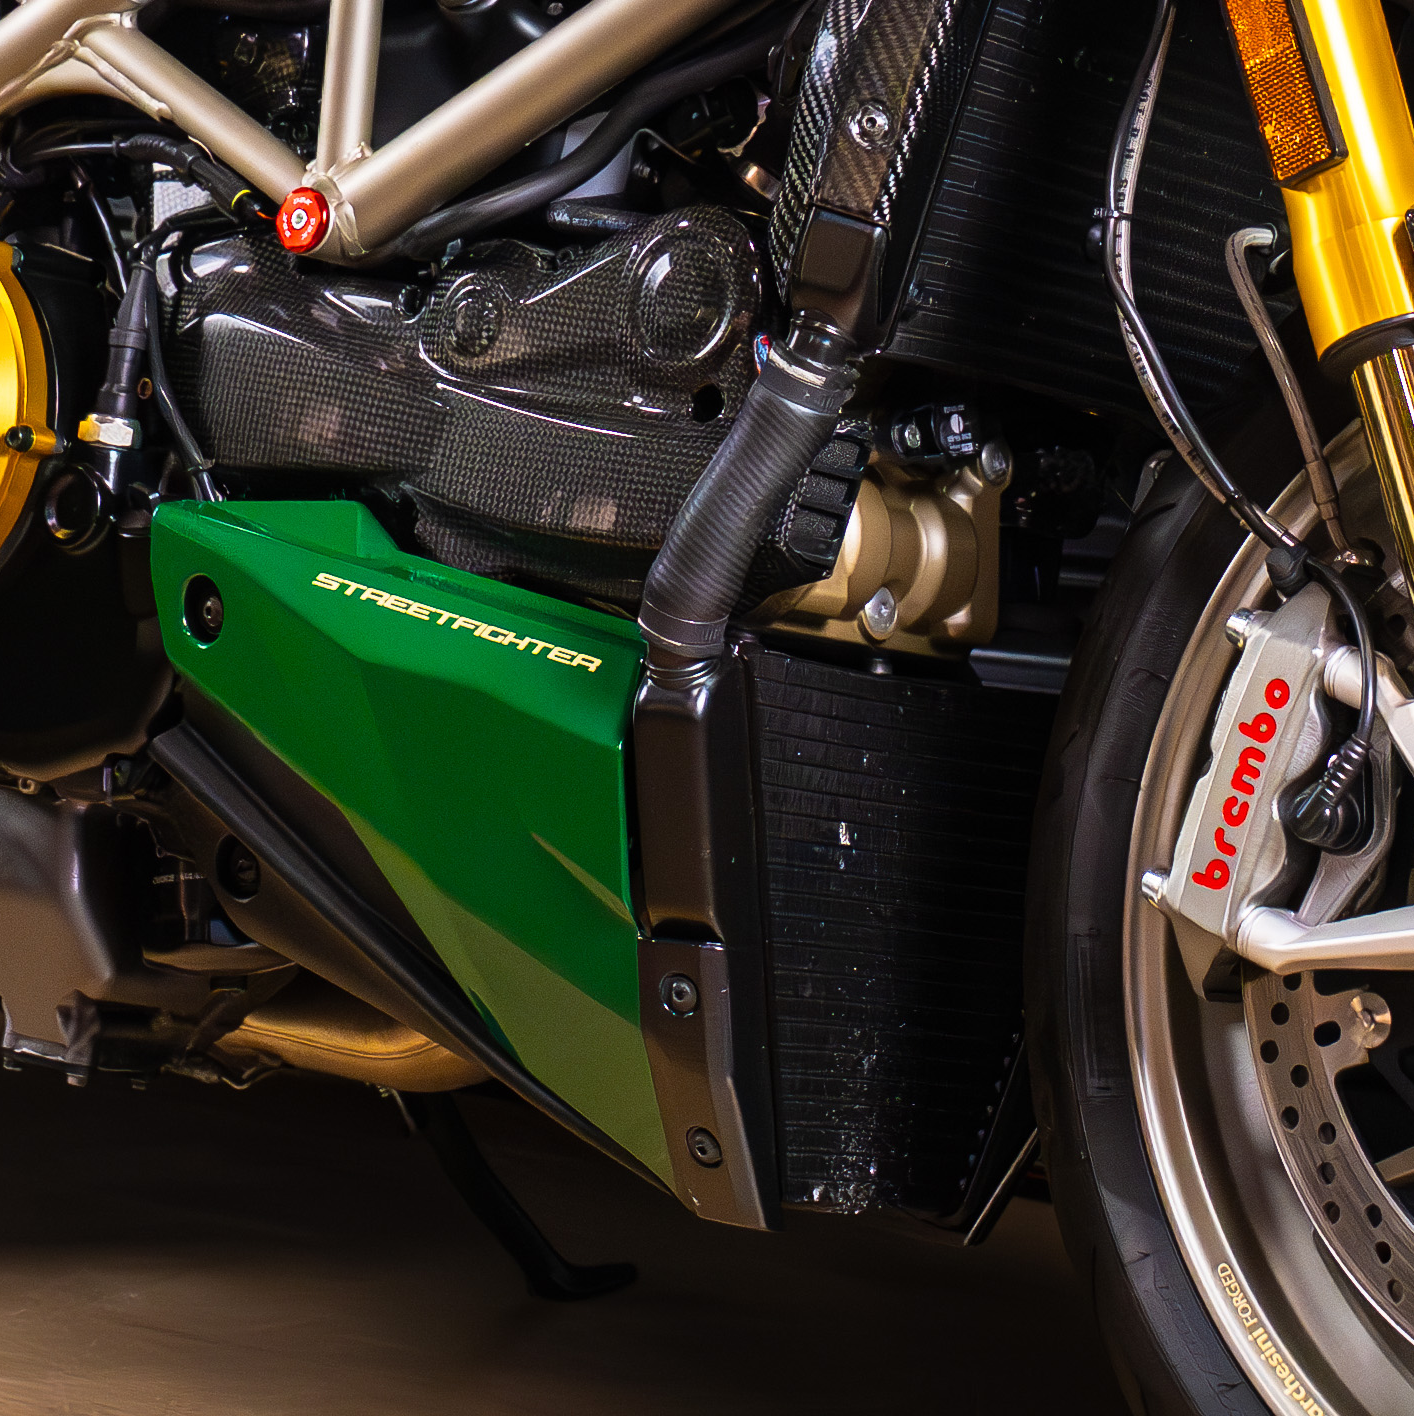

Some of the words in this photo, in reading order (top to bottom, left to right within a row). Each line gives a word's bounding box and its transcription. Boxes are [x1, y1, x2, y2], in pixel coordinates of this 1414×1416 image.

[311, 572, 602, 672] STREETFIGHTER
[1191, 678, 1290, 890] brembo
[1217, 1262, 1258, 1328] FORGED
[1248, 1327, 1325, 1416] archesini
